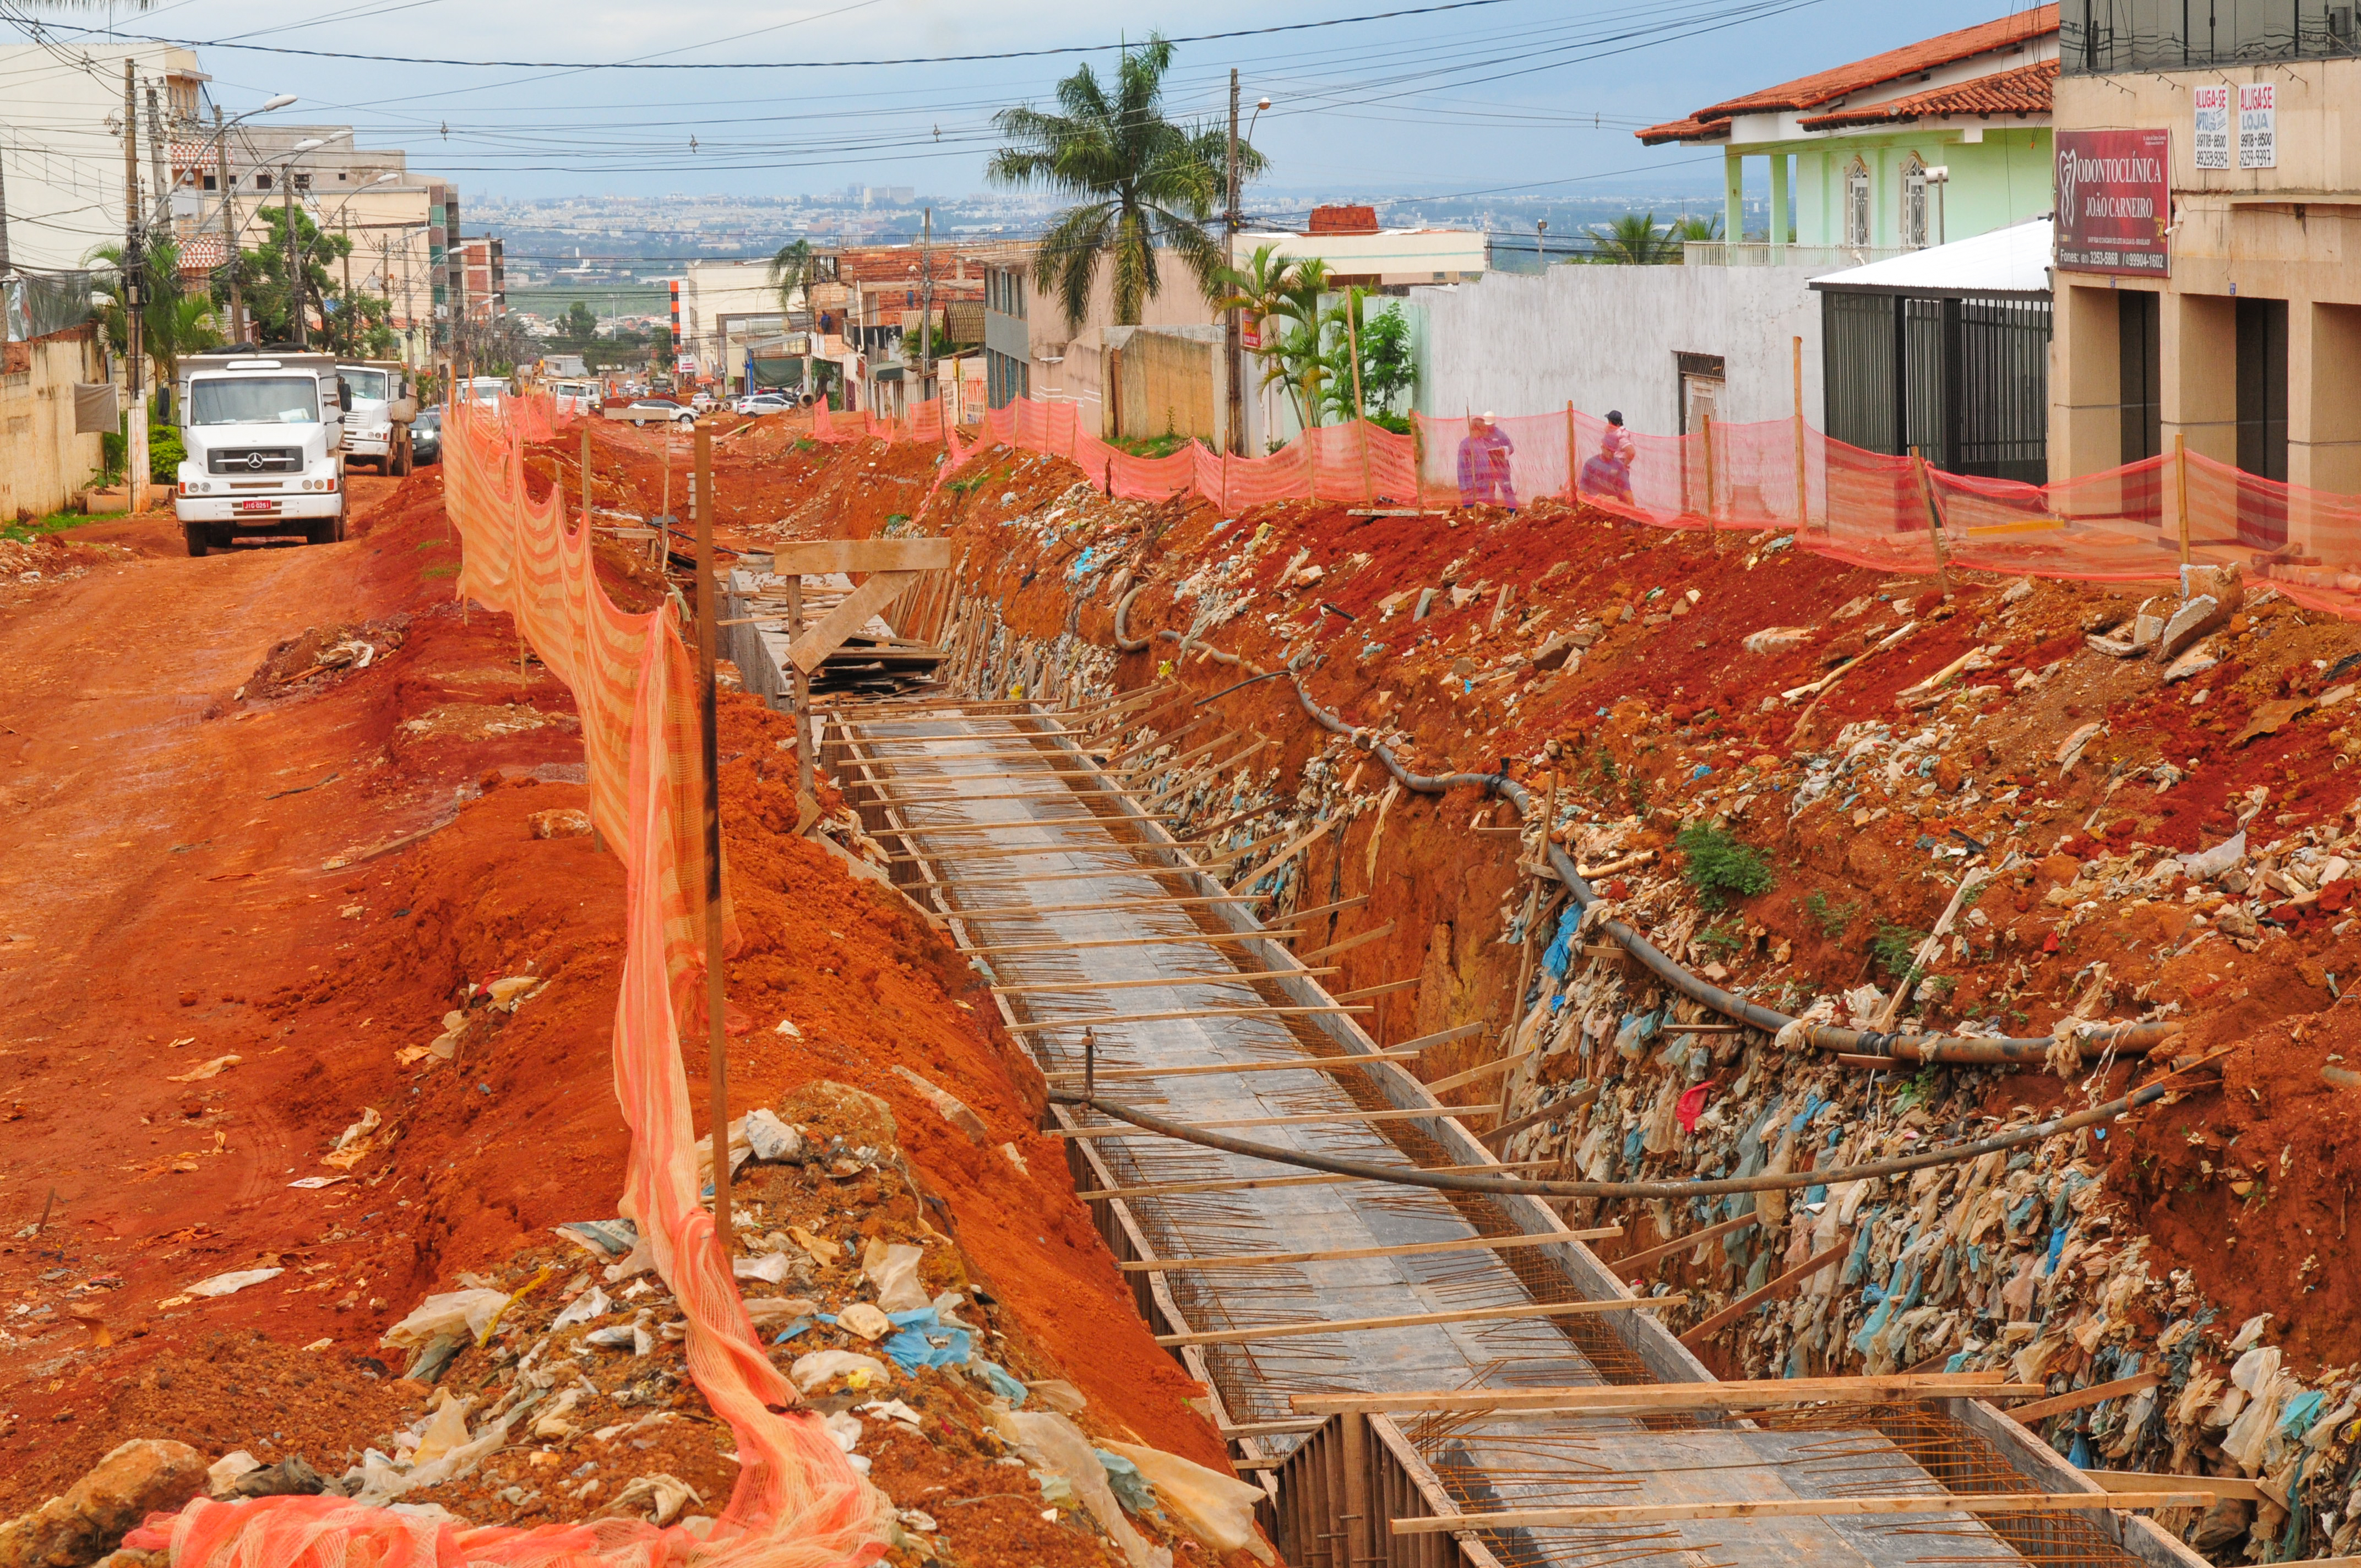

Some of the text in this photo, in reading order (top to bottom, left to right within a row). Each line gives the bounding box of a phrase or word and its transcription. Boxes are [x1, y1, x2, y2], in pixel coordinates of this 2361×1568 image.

[2196, 89, 2226, 108] ALUGA-SE
[2240, 86, 2272, 111] ALUGA-SE
[2195, 112, 2208, 130] APTO
[2242, 113, 2268, 130] LOJA
[2077, 150, 2162, 183] ODONTOCLÍNICA
[2086, 192, 2153, 218] JOÃO CARNEIRO
[2060, 249, 2079, 263] Fones:
[2081, 254, 2089, 264] (61)
[2090, 251, 2118, 265] 3253-5868
[2129, 253, 2163, 268] 99904-1602
